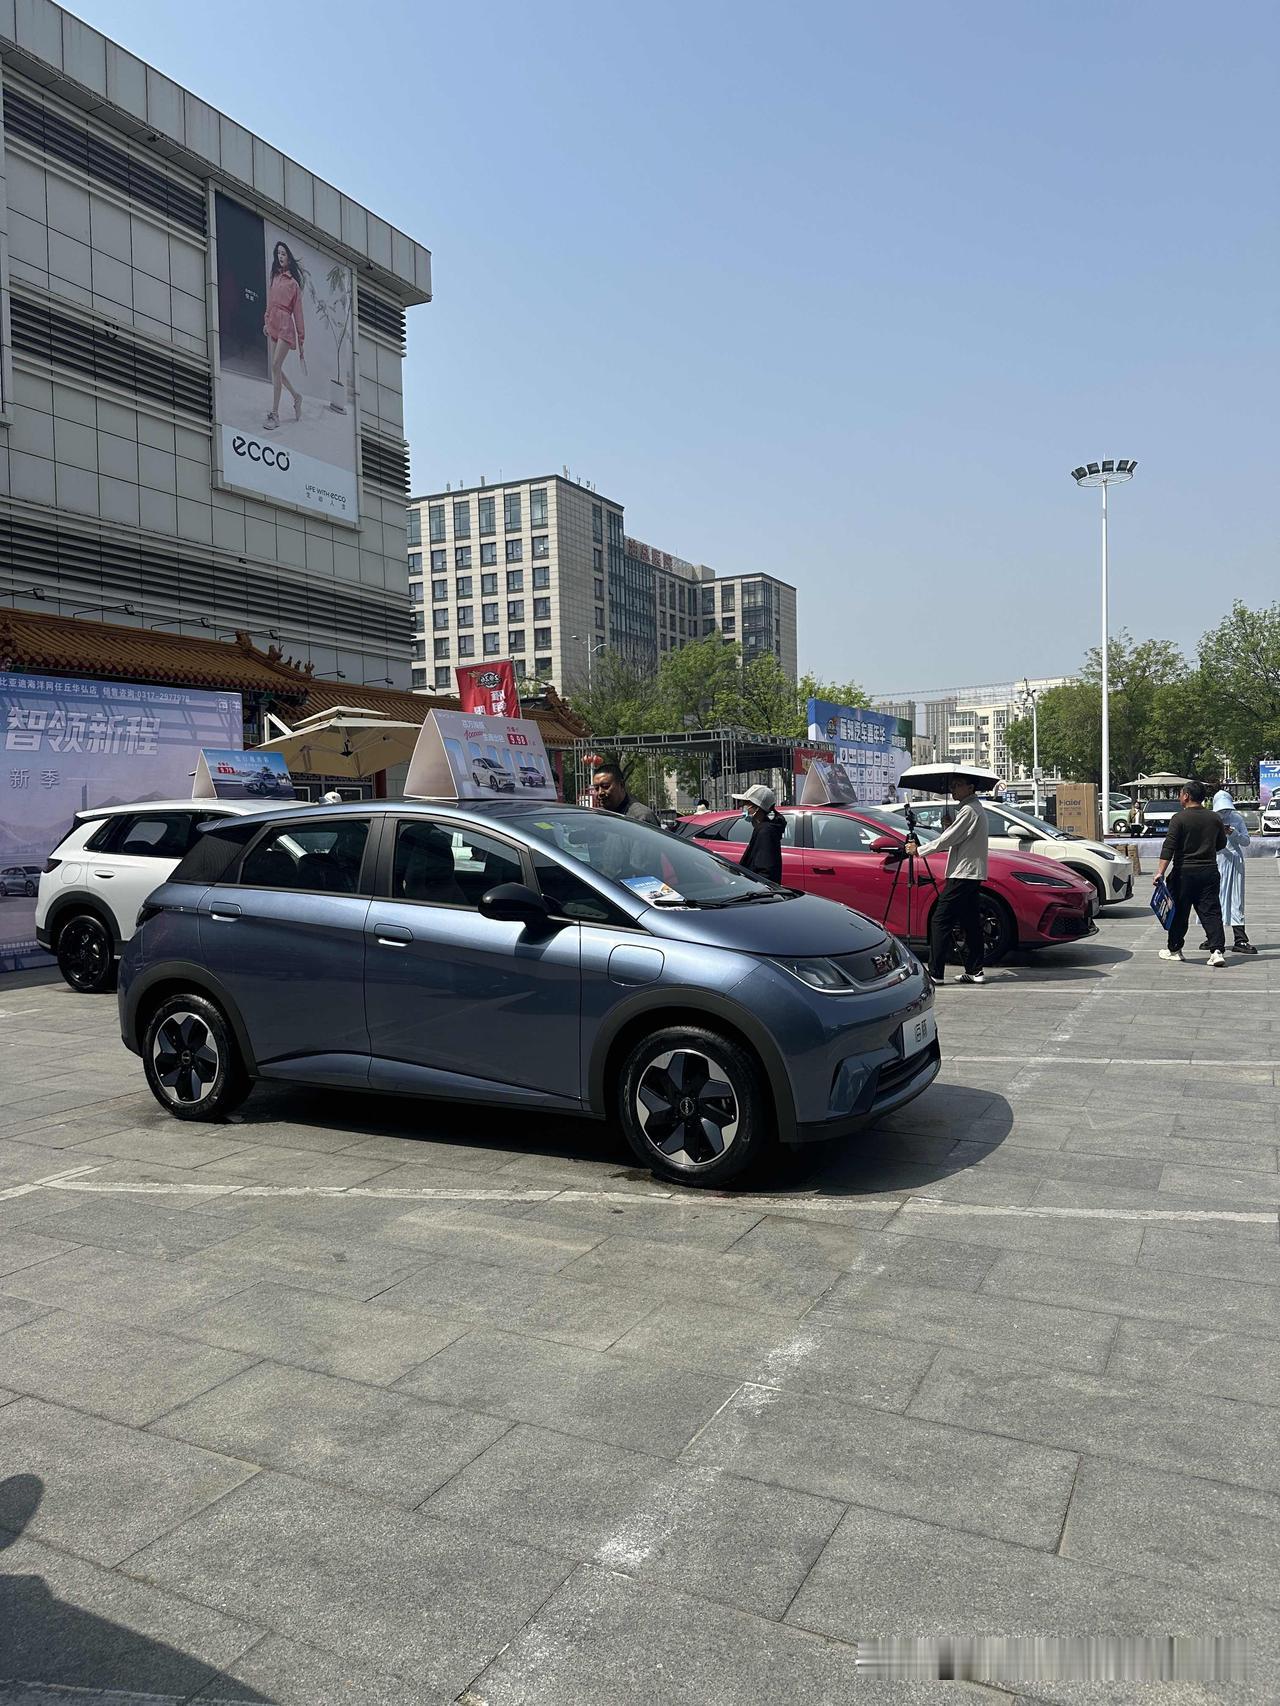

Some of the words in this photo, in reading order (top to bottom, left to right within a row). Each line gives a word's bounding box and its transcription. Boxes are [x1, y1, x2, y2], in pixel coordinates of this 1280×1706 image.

[232, 436, 290, 471] ecco
[305, 483, 316, 493] LIFE
[316, 487, 330, 497] WITH
[5, 706, 160, 756] 智领新程
